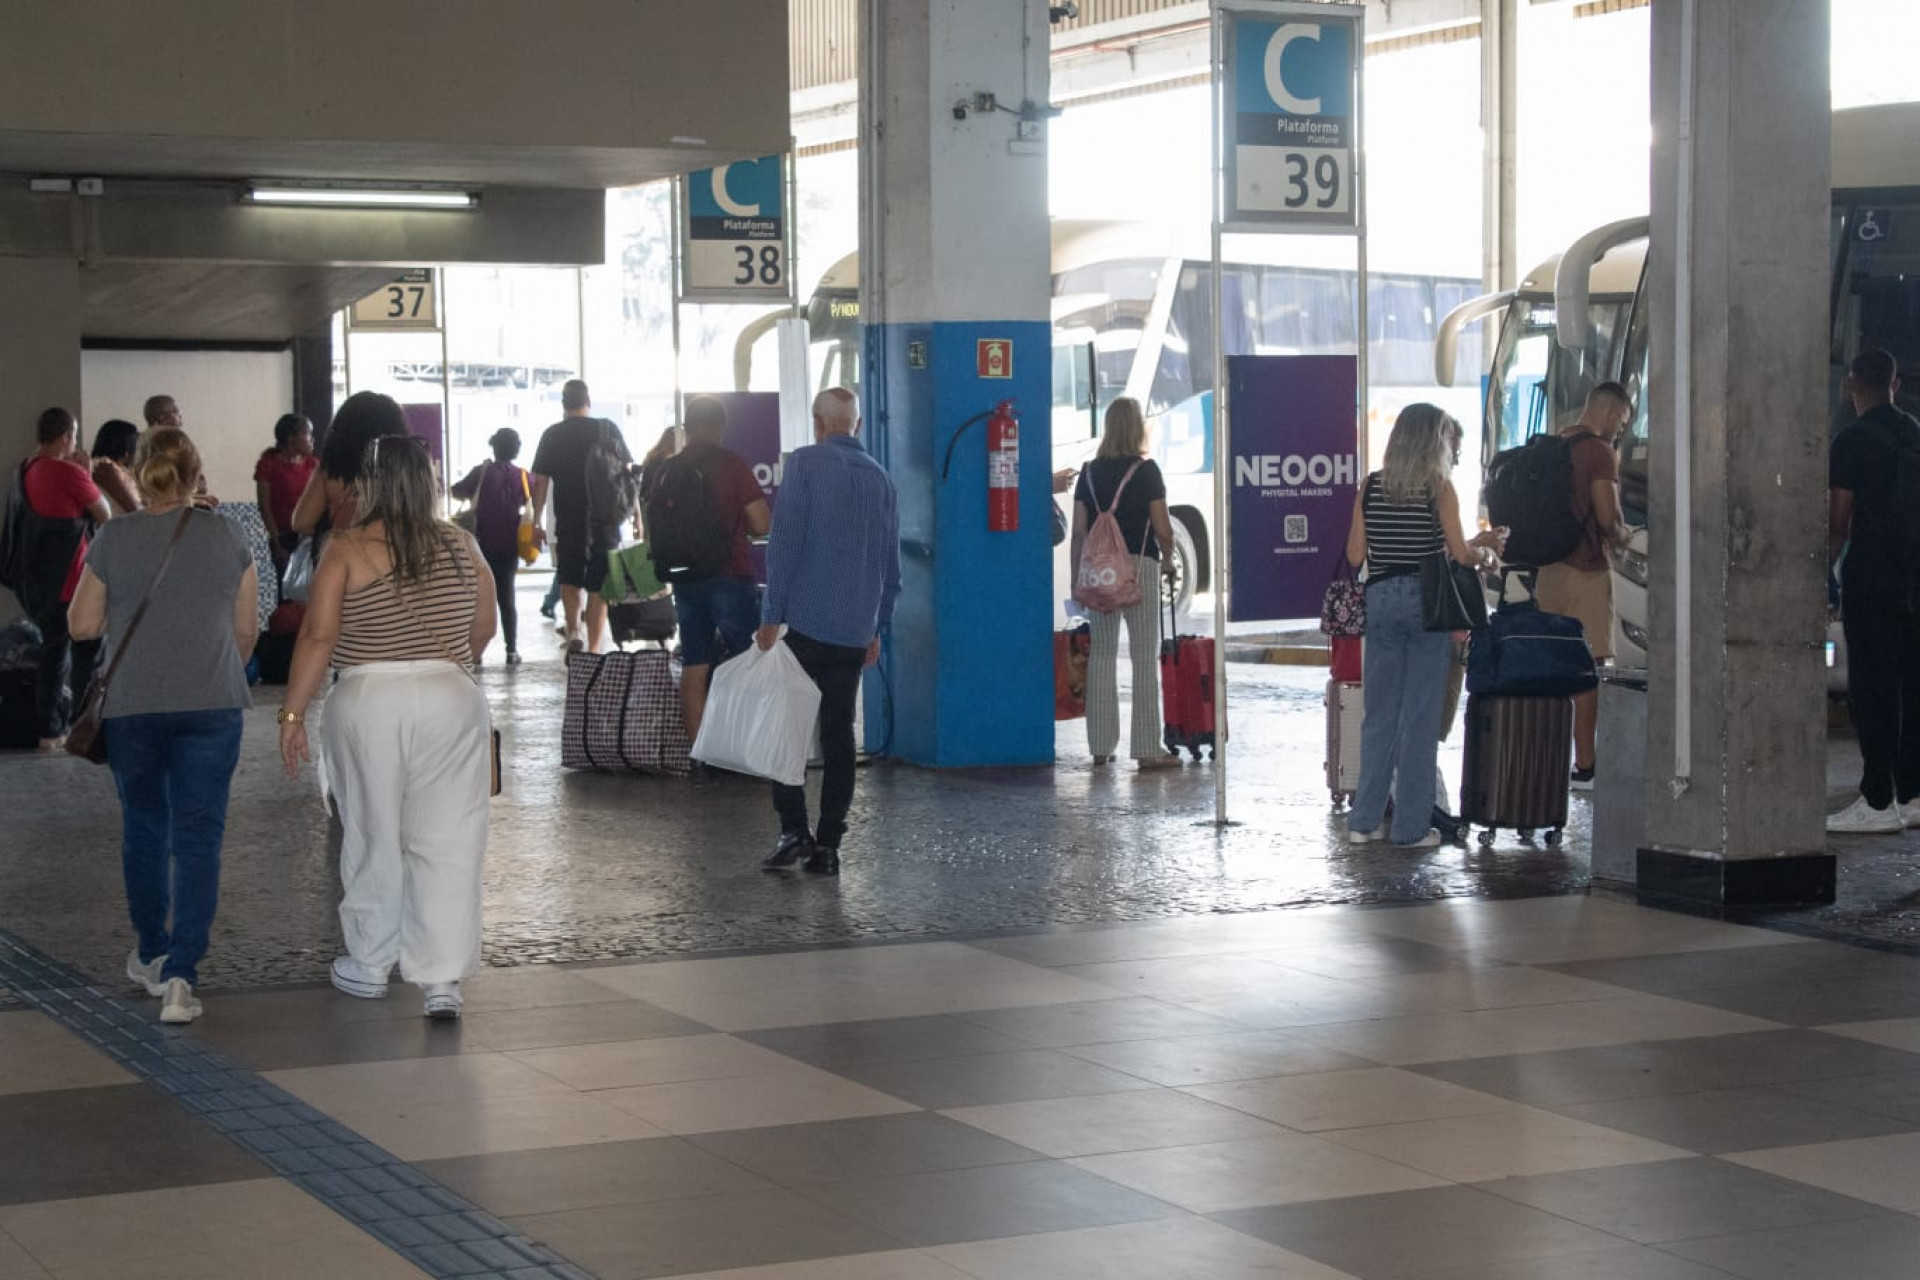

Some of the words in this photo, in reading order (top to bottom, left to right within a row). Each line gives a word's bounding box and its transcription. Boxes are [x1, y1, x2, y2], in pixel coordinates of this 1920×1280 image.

[1264, 23, 1321, 115] C
[1278, 118, 1339, 134] Plataforma
[712, 158, 760, 217] C
[1284, 153, 1340, 209] 39
[723, 219, 775, 231] Plataforma
[734, 245, 780, 285] 38
[387, 286, 424, 318] 37
[1235, 454, 1354, 487] NEOOH
